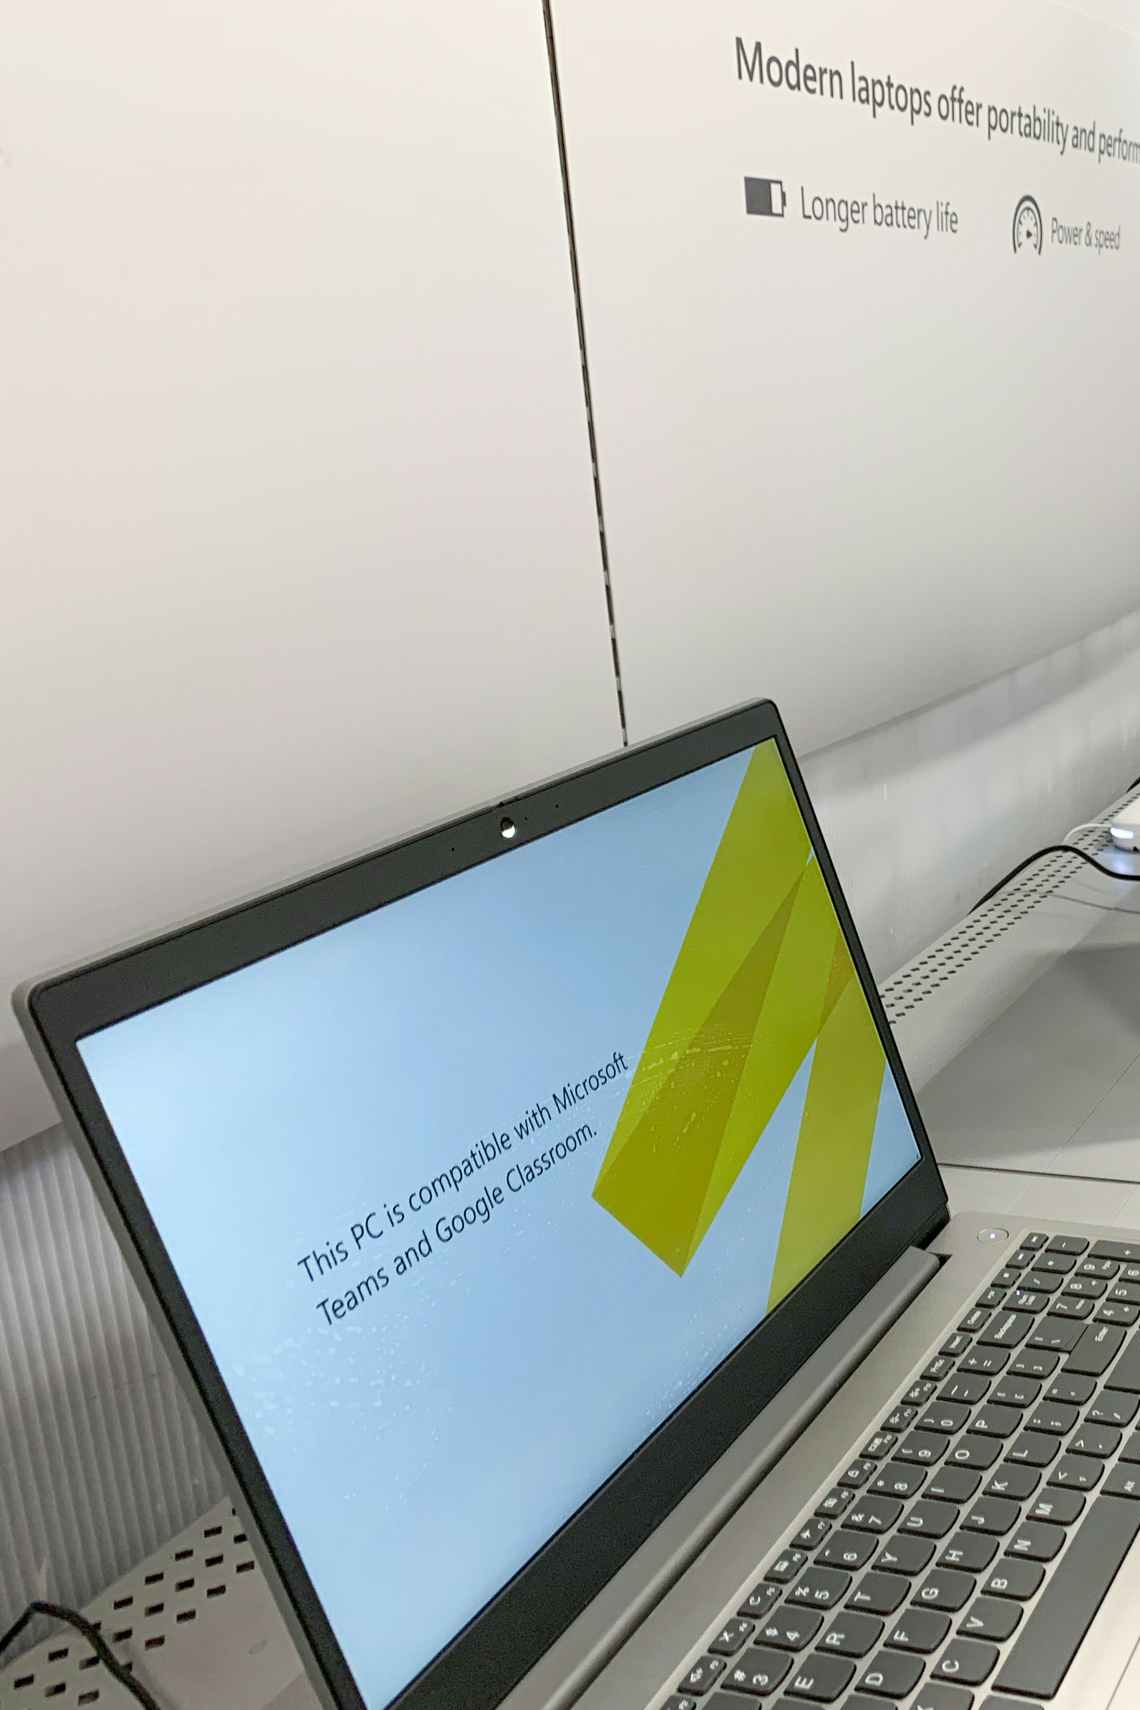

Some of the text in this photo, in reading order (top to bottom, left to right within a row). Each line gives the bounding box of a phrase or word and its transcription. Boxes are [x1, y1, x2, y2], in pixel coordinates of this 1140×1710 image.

[735, 36, 843, 100] Modern
[851, 61, 932, 125] laptops
[938, 85, 982, 128] offer
[987, 104, 1068, 155] portability
[1071, 122, 1095, 152] and
[801, 186, 959, 239] Longer battery life
[1050, 216, 1121, 256] Power & speed
[297, 1051, 629, 1282] This PC is compatible with Microsoft
[316, 1121, 597, 1326] Teams and Google Classroom.
